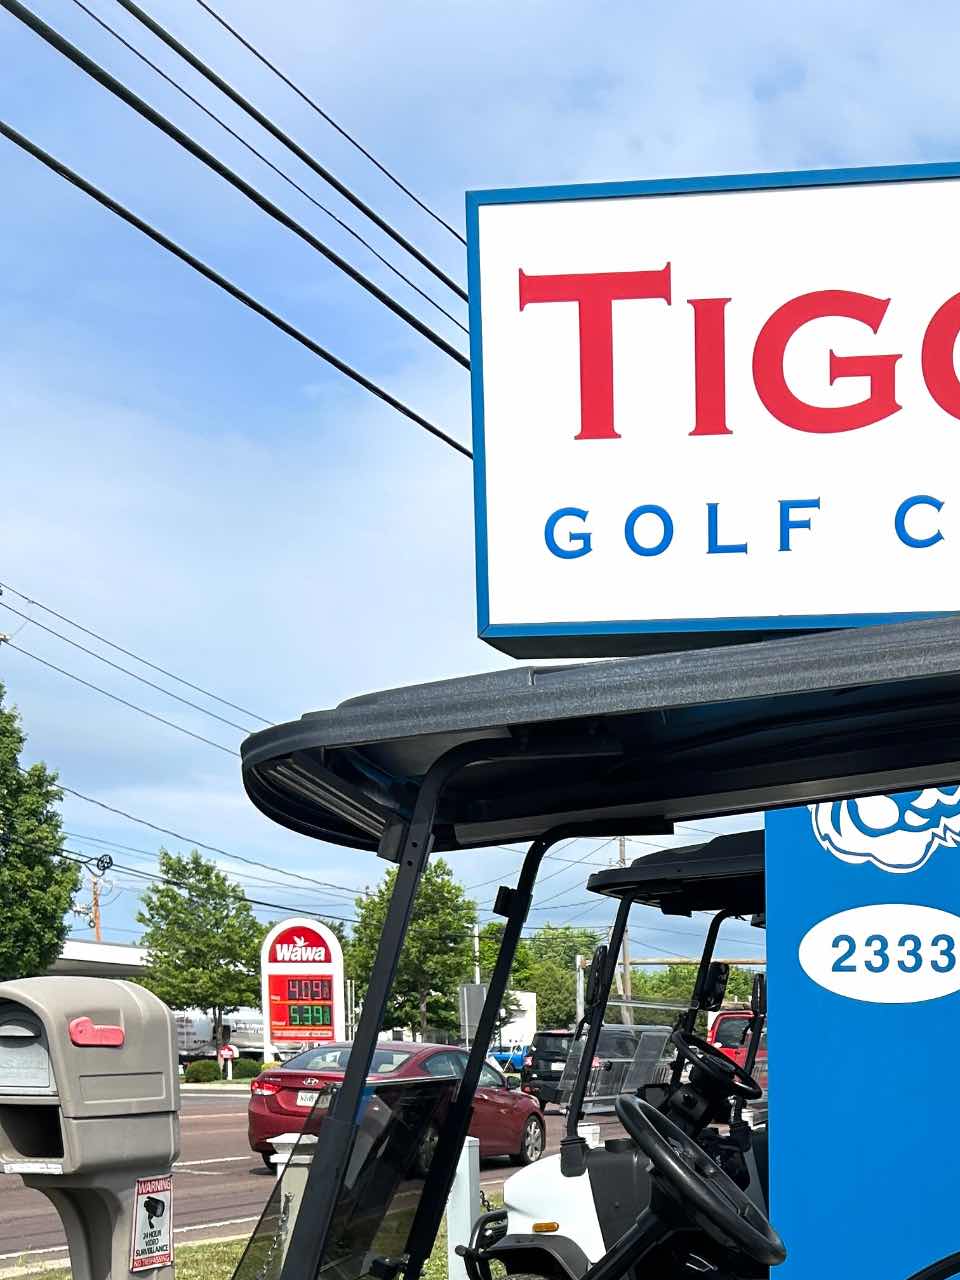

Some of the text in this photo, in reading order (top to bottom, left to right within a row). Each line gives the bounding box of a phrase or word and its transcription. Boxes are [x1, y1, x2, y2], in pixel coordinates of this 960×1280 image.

[544, 497, 821, 560] GOLF
[275, 943, 325, 962] Wawa
[831, 934, 957, 974] 2333
[138, 1178, 171, 1194] WARNING
[150, 1229, 161, 1238] HOUR
[135, 1244, 169, 1257] SURVEILLANCE
